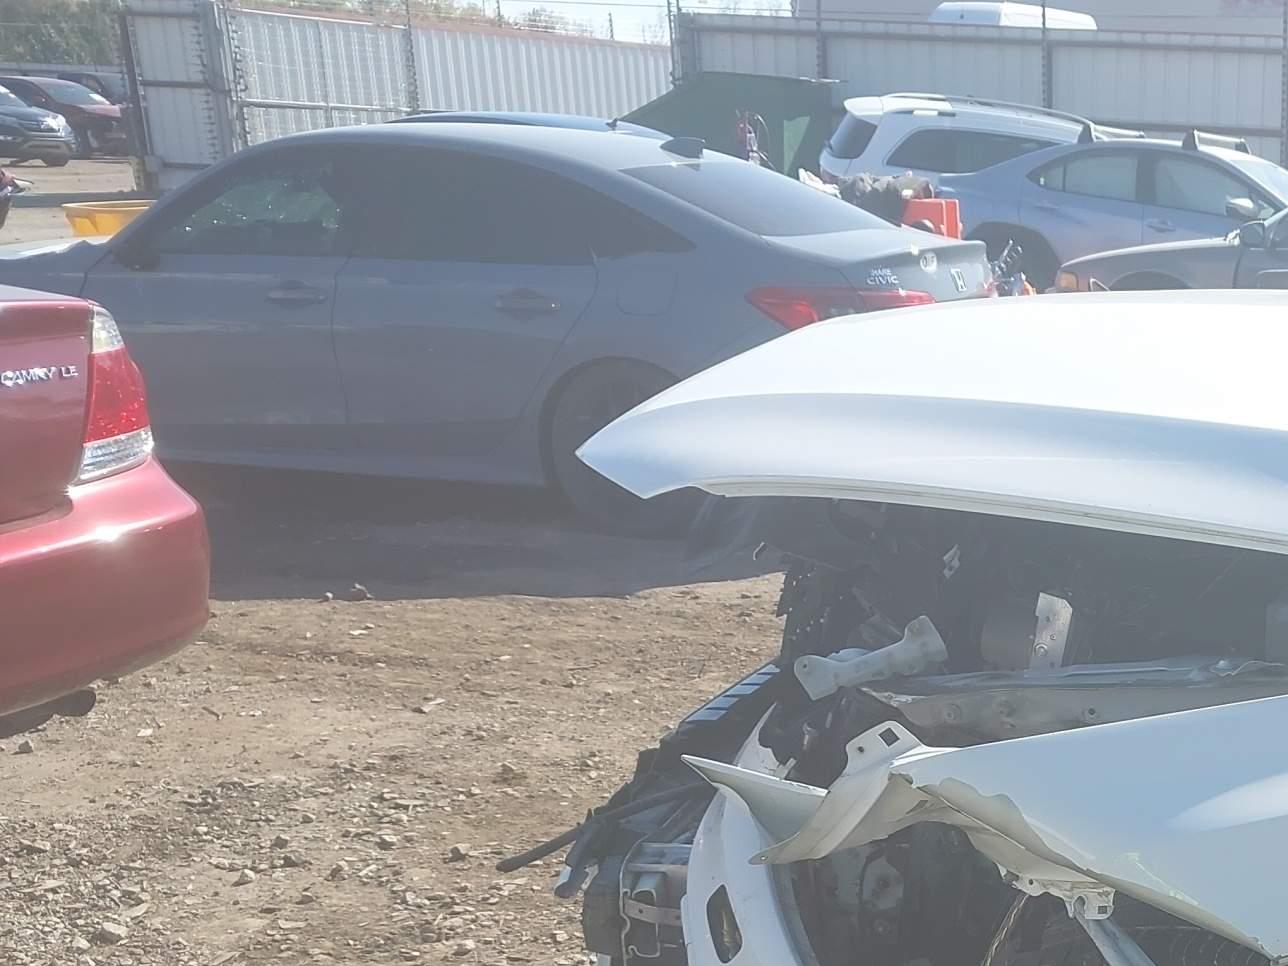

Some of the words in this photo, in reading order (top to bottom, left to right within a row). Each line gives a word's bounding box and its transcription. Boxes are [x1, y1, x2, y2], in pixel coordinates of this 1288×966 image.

[867, 276, 899, 285] CIVIC
[1, 366, 57, 387] CAMRY
[60, 365, 79, 377] LE
